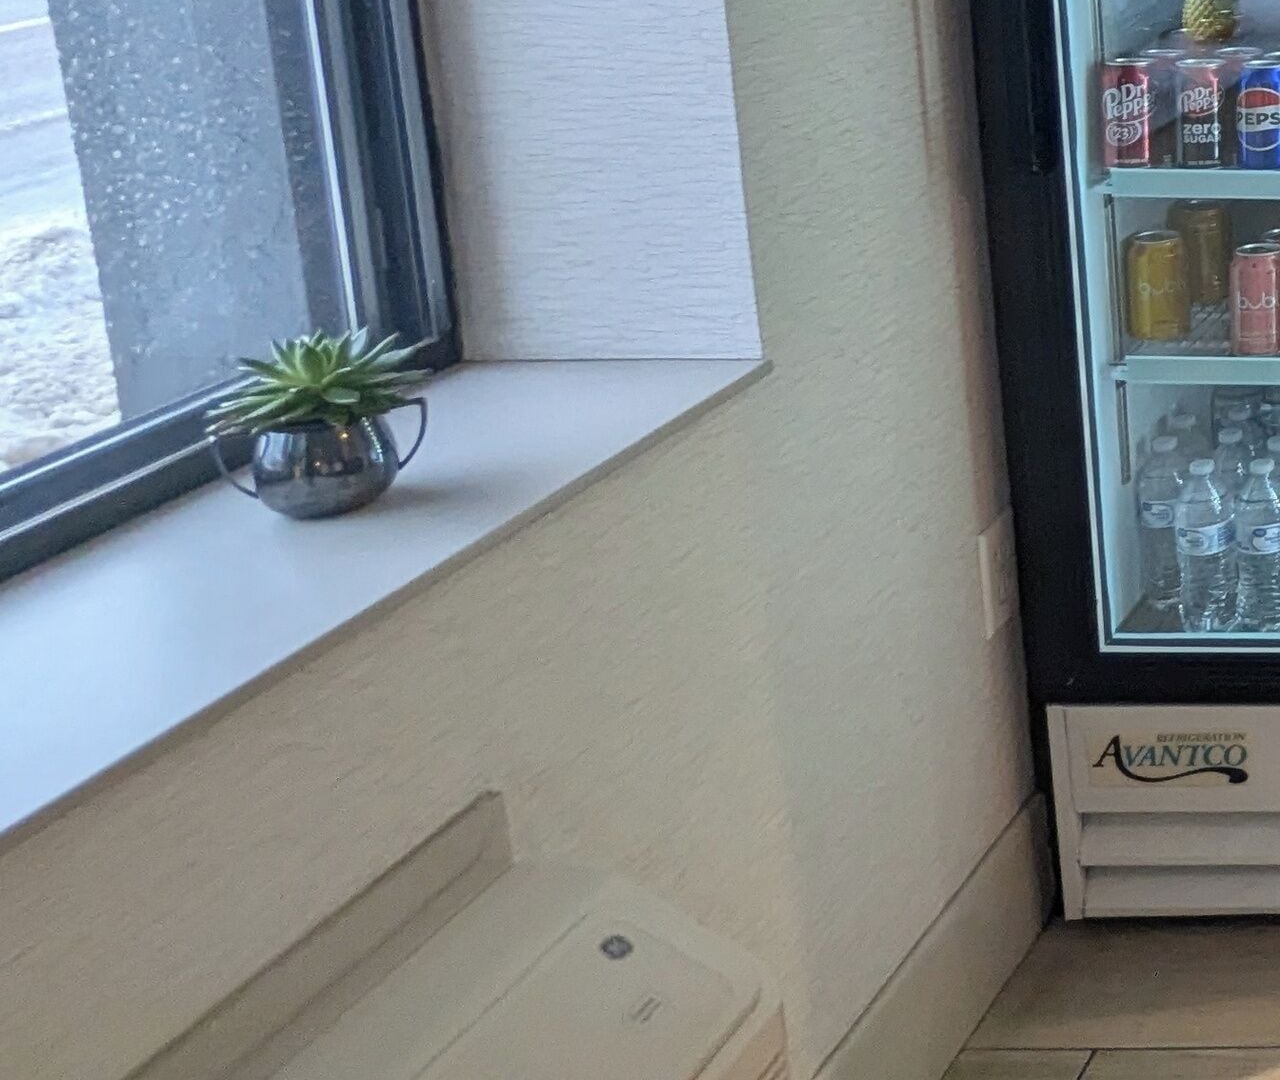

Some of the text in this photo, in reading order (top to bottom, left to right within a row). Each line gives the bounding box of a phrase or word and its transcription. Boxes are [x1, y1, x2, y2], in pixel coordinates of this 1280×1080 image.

[1121, 83, 1144, 104] Dr
[1179, 90, 1223, 114] Pepper
[1192, 87, 1213, 100] Dr
[1103, 88, 1155, 120] Pepper
[1112, 123, 1129, 139] 23
[1183, 122, 1222, 134] zero
[1183, 134, 1222, 143] SUGAR
[1092, 734, 1248, 773] AVANTCO
